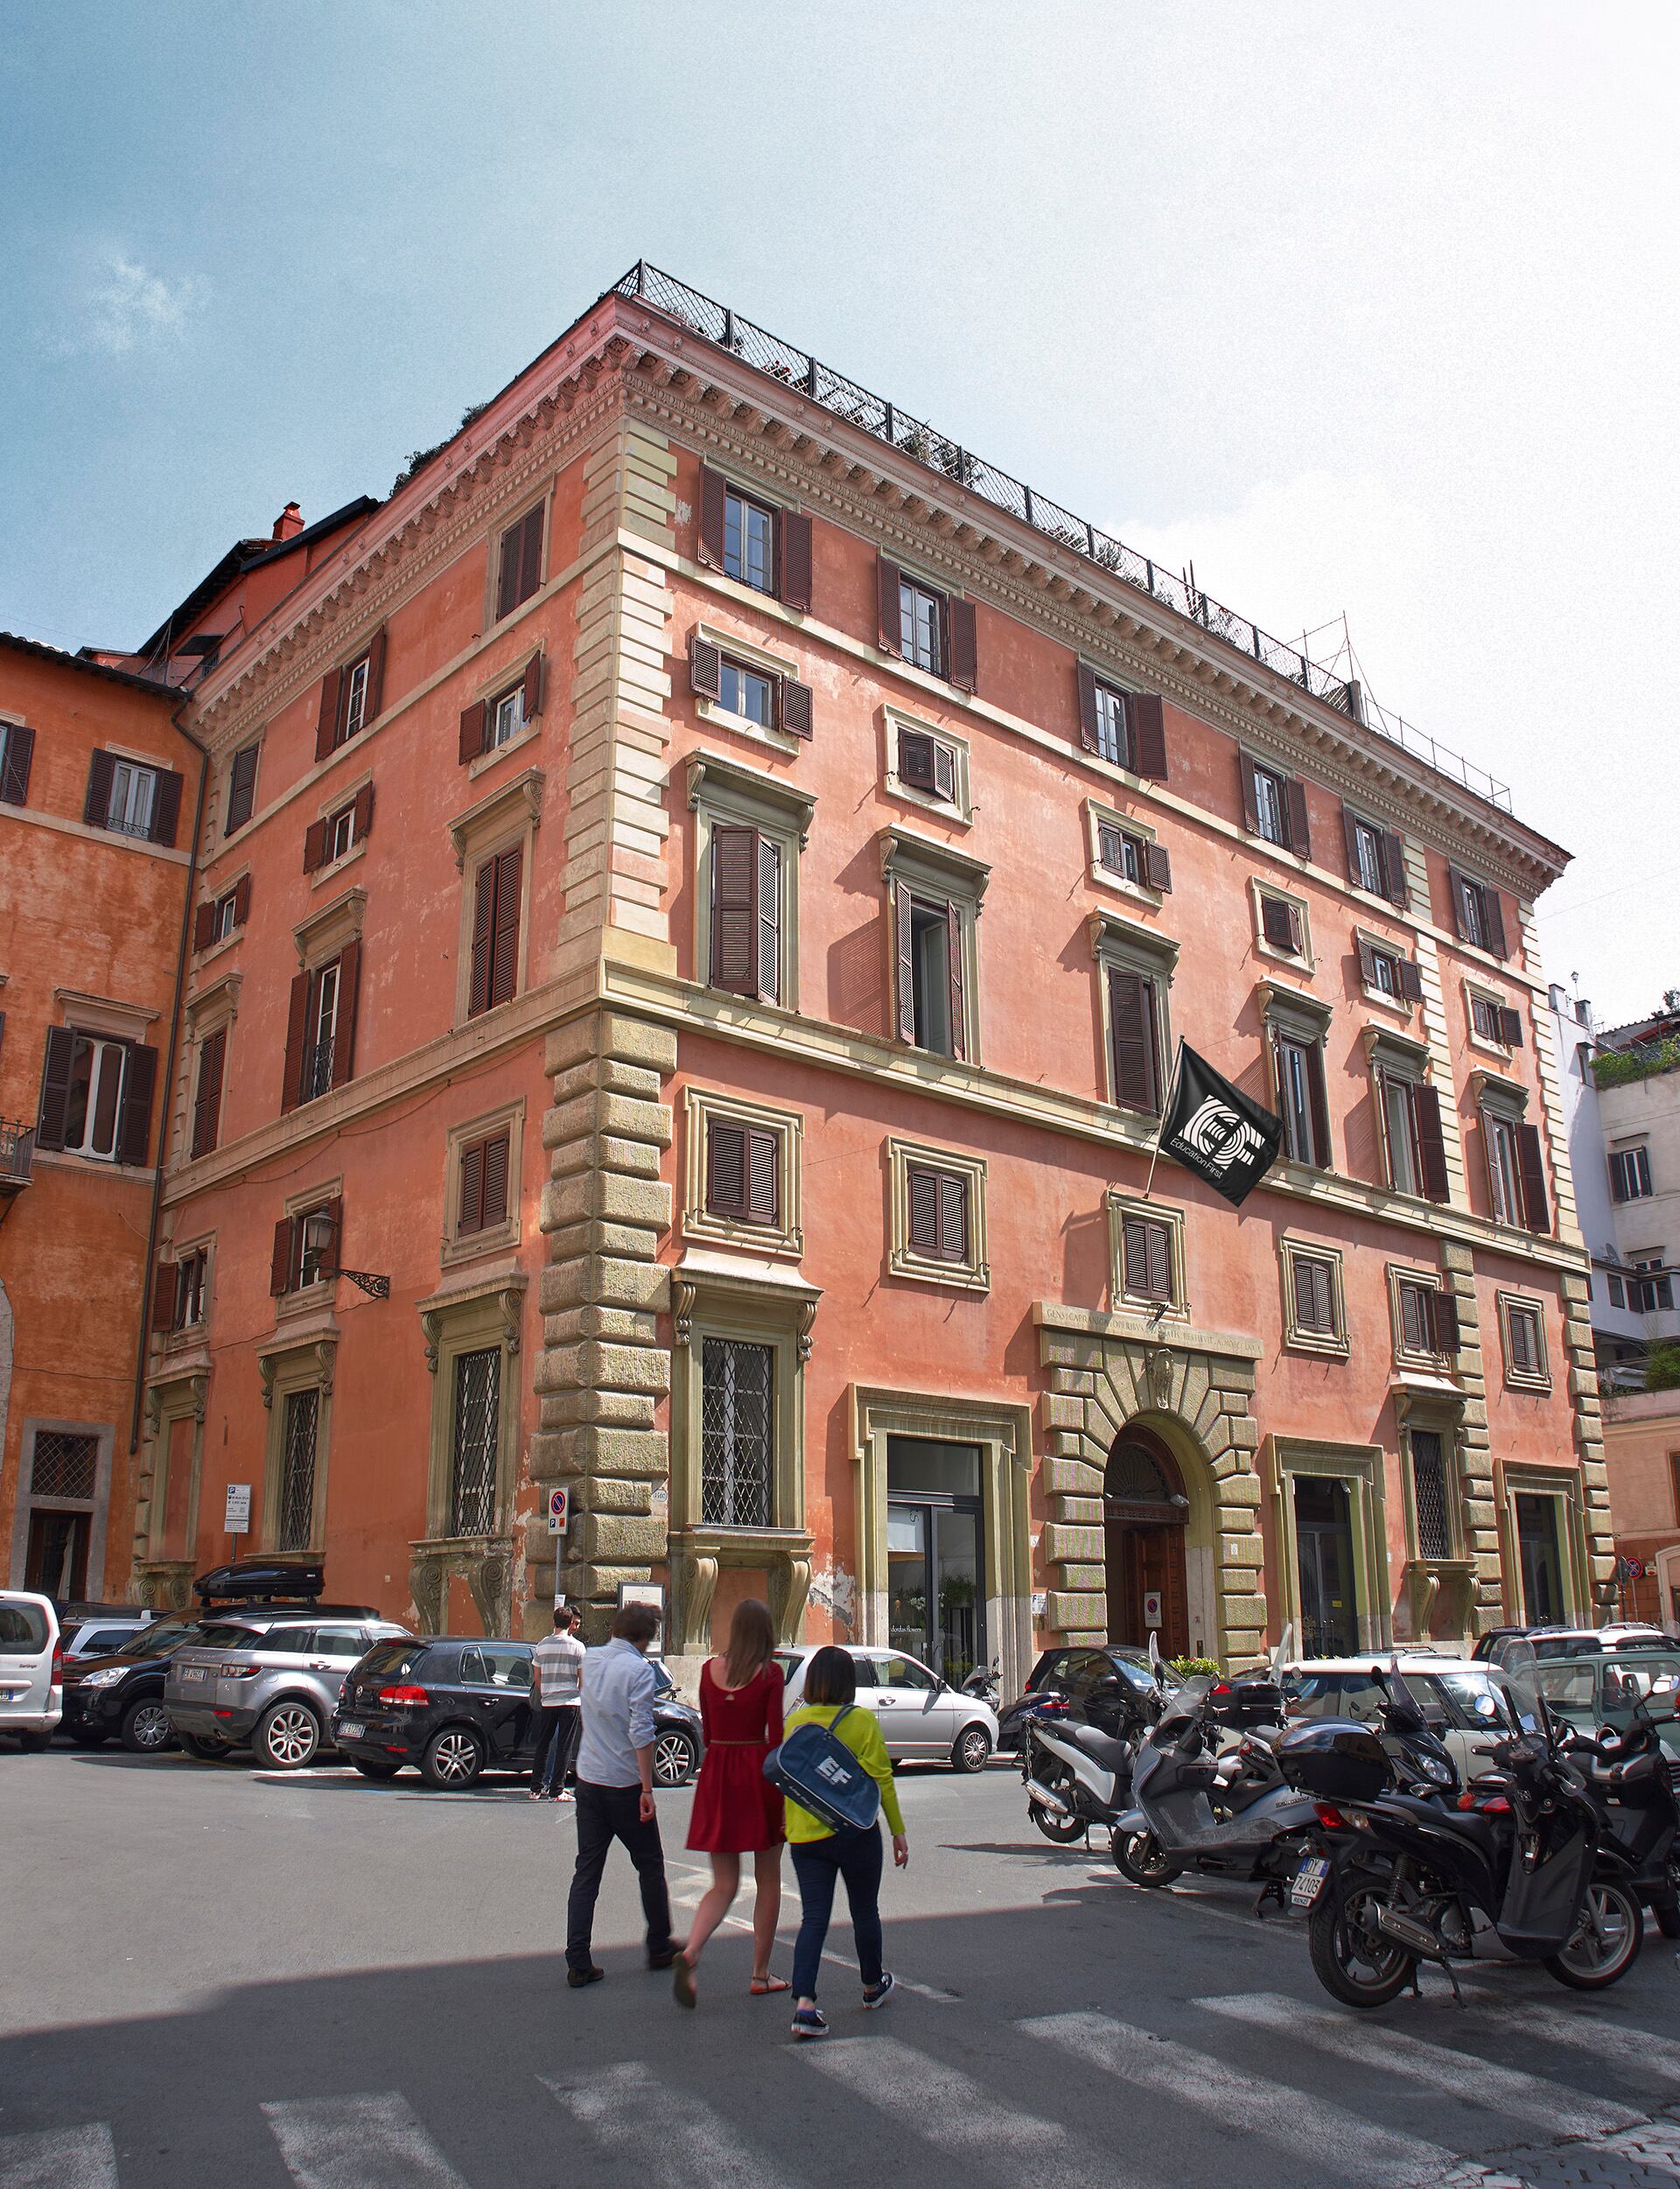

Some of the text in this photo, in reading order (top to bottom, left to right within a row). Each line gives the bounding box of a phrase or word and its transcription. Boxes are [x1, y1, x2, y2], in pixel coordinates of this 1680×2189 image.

[1170, 1137, 1223, 1179] Education First
[1046, 1309, 1065, 1320] GENS
[817, 1755, 852, 1784] EF
[1306, 1858, 1320, 1873] DY
[1293, 1876, 1320, 1894] 74103
